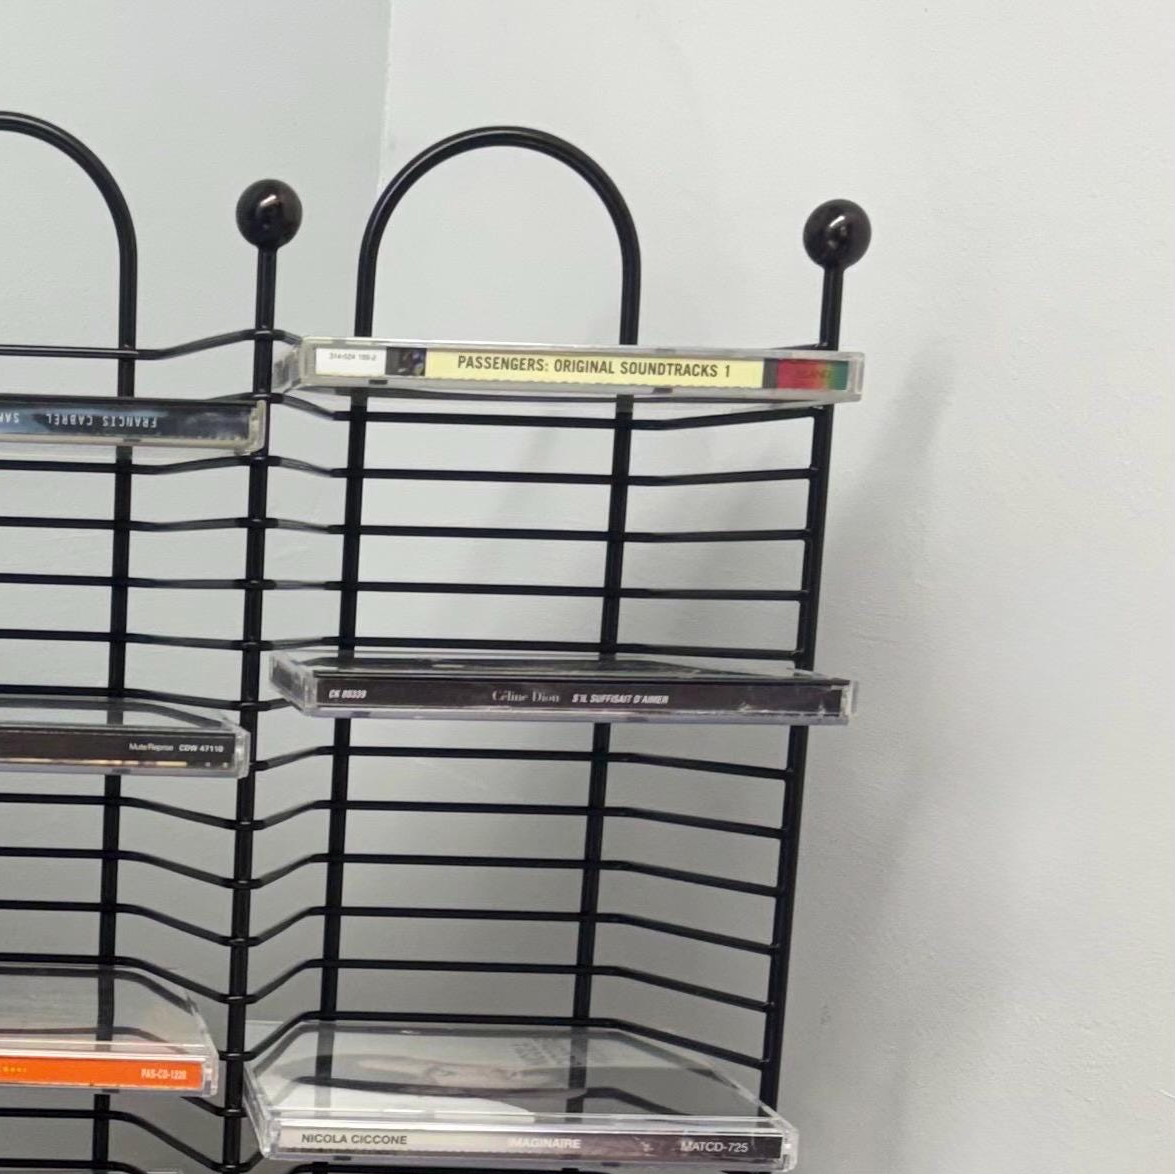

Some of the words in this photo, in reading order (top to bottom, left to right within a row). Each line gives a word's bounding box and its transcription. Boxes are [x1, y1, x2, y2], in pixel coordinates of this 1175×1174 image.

[458, 355, 550, 373] PASSENGERS:
[554, 360, 615, 375] ORIGINAL
[620, 361, 719, 378] SOUNDTRACKS
[46, 413, 94, 427] CABREL
[102, 415, 158, 429] FRANCIS
[491, 689, 527, 702] Céline
[532, 690, 560, 703] Dion
[571, 693, 589, 704] S'IL
[589, 693, 631, 704] SUFFISAIT
[632, 694, 669, 705] D'AIMER
[178, 744, 198, 752] CDW
[301, 1133, 348, 1144] NICOLA
[351, 1134, 408, 1146] CICCONE
[680, 1140, 749, 1153] MATCD-725
